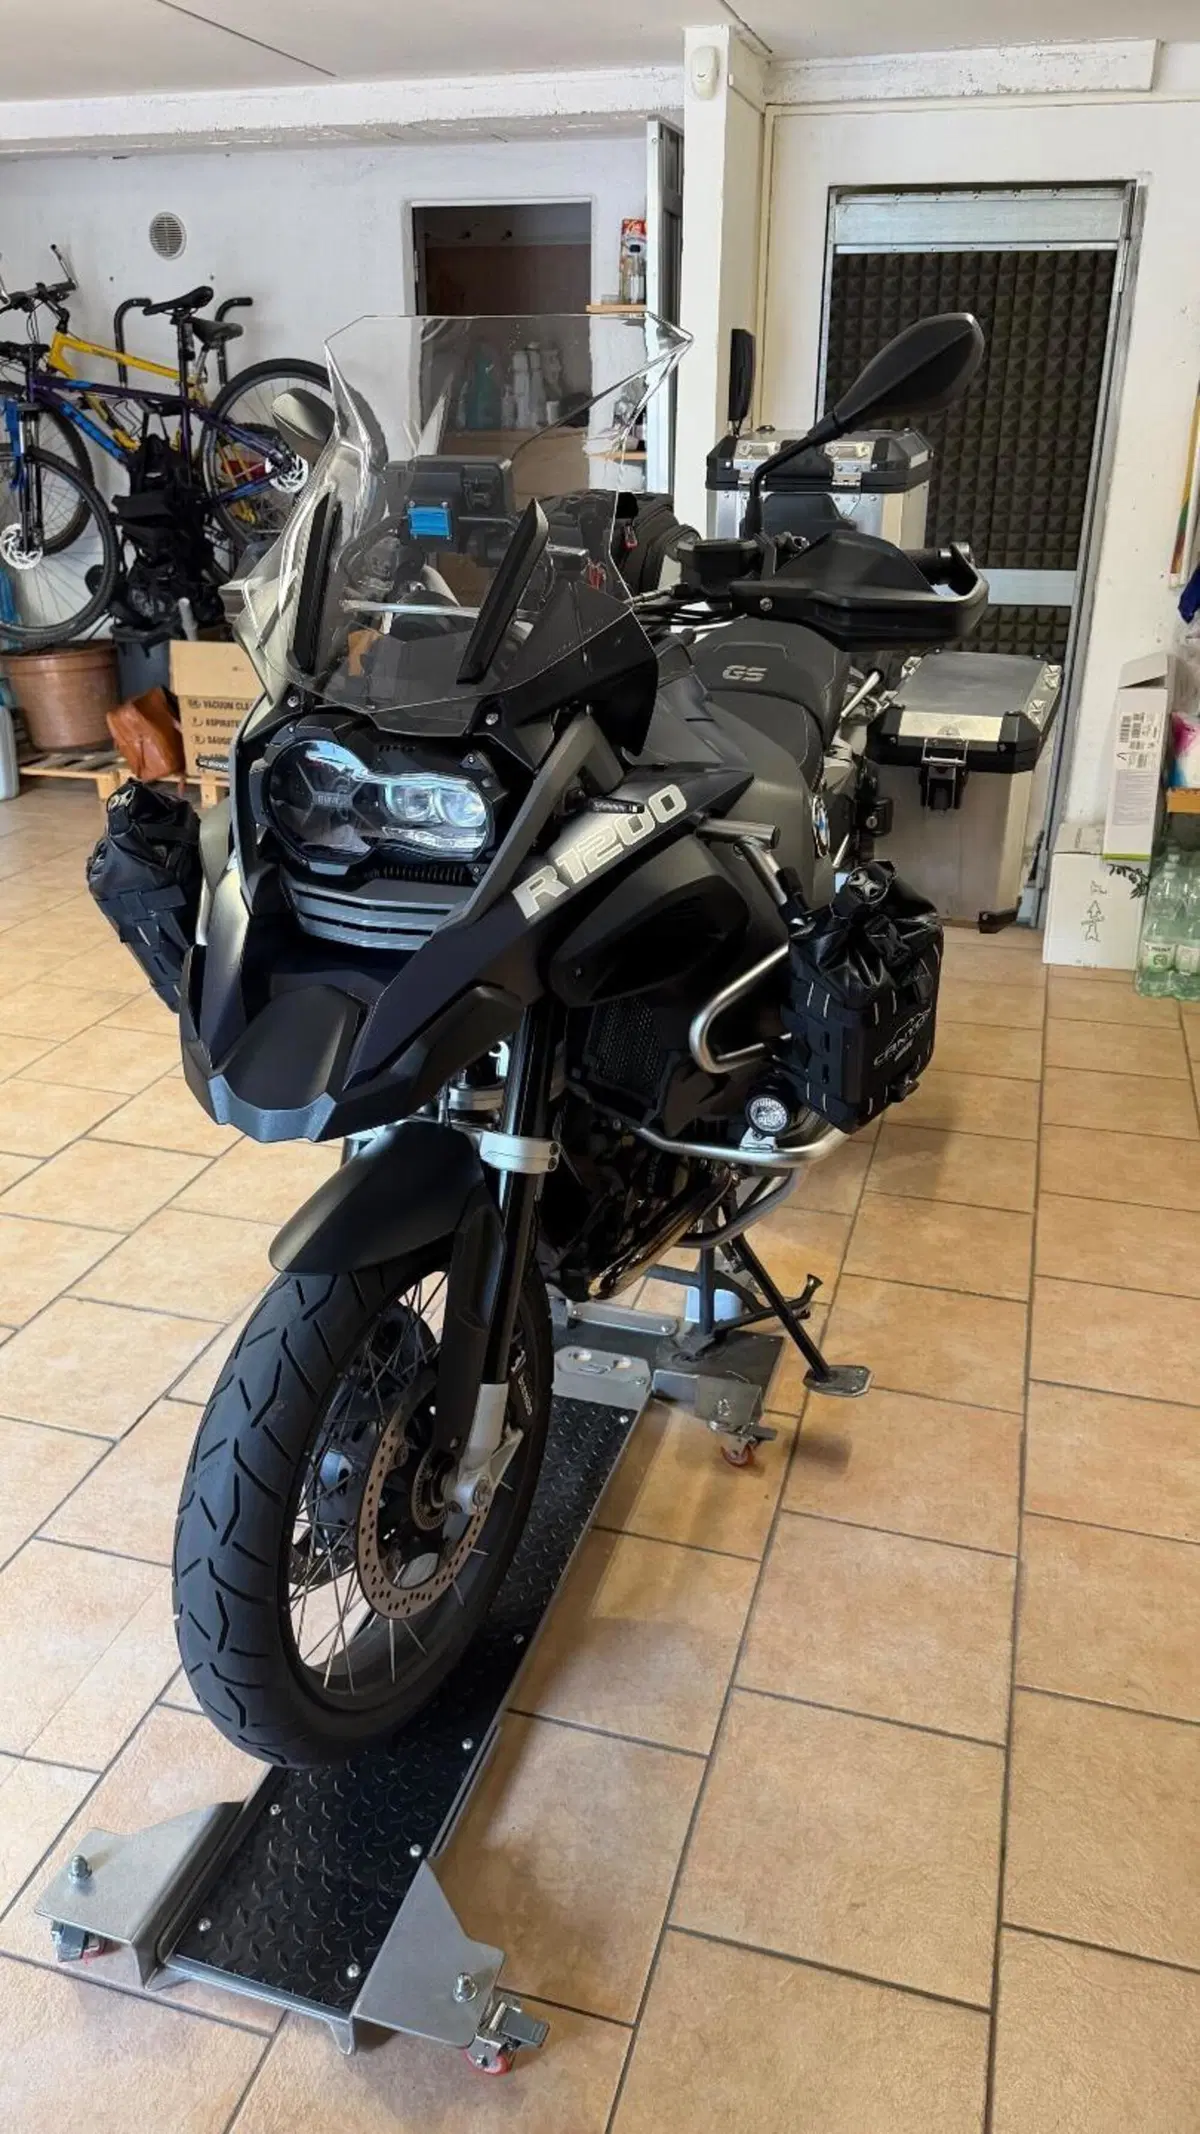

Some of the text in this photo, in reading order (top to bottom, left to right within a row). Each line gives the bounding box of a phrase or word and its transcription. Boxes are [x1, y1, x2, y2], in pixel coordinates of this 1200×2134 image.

[722, 665, 767, 682] GS
[203, 700, 234, 710] VACUUM
[511, 783, 688, 920] R1200
